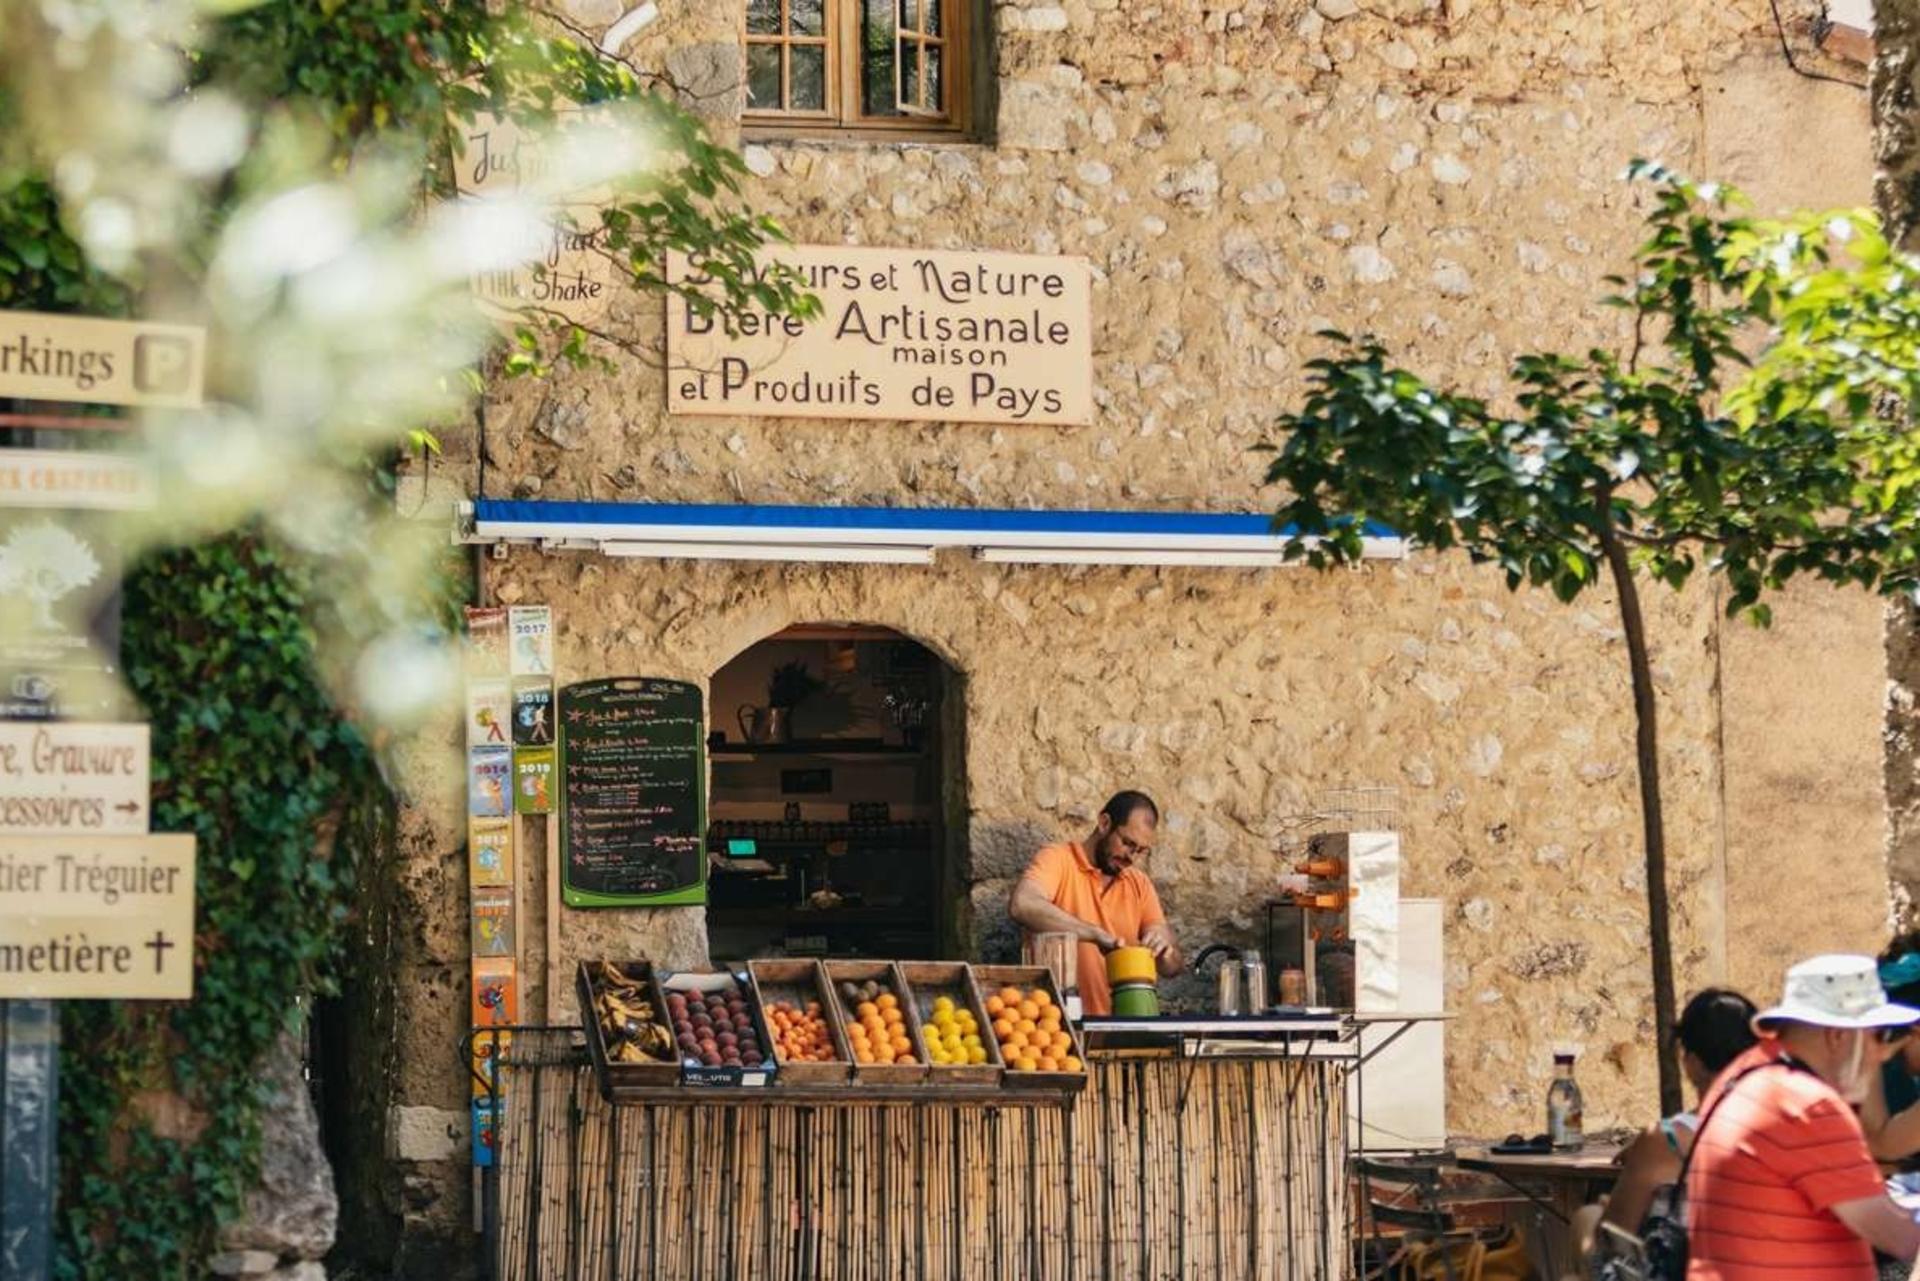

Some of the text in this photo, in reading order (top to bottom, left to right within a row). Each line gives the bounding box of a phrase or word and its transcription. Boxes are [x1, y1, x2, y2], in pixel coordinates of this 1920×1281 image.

[533, 270, 601, 300] Shake
[870, 263, 898, 291] et
[913, 259, 1064, 303] Nature
[835, 299, 1070, 345] Artisanale
[1, 335, 115, 391] rkings
[893, 343, 1007, 366] maison
[680, 356, 1062, 418] et Produits de Pays
[32, 729, 136, 775] Gravure
[0, 784, 105, 827] essoires
[55, 853, 180, 905] Tréguier
